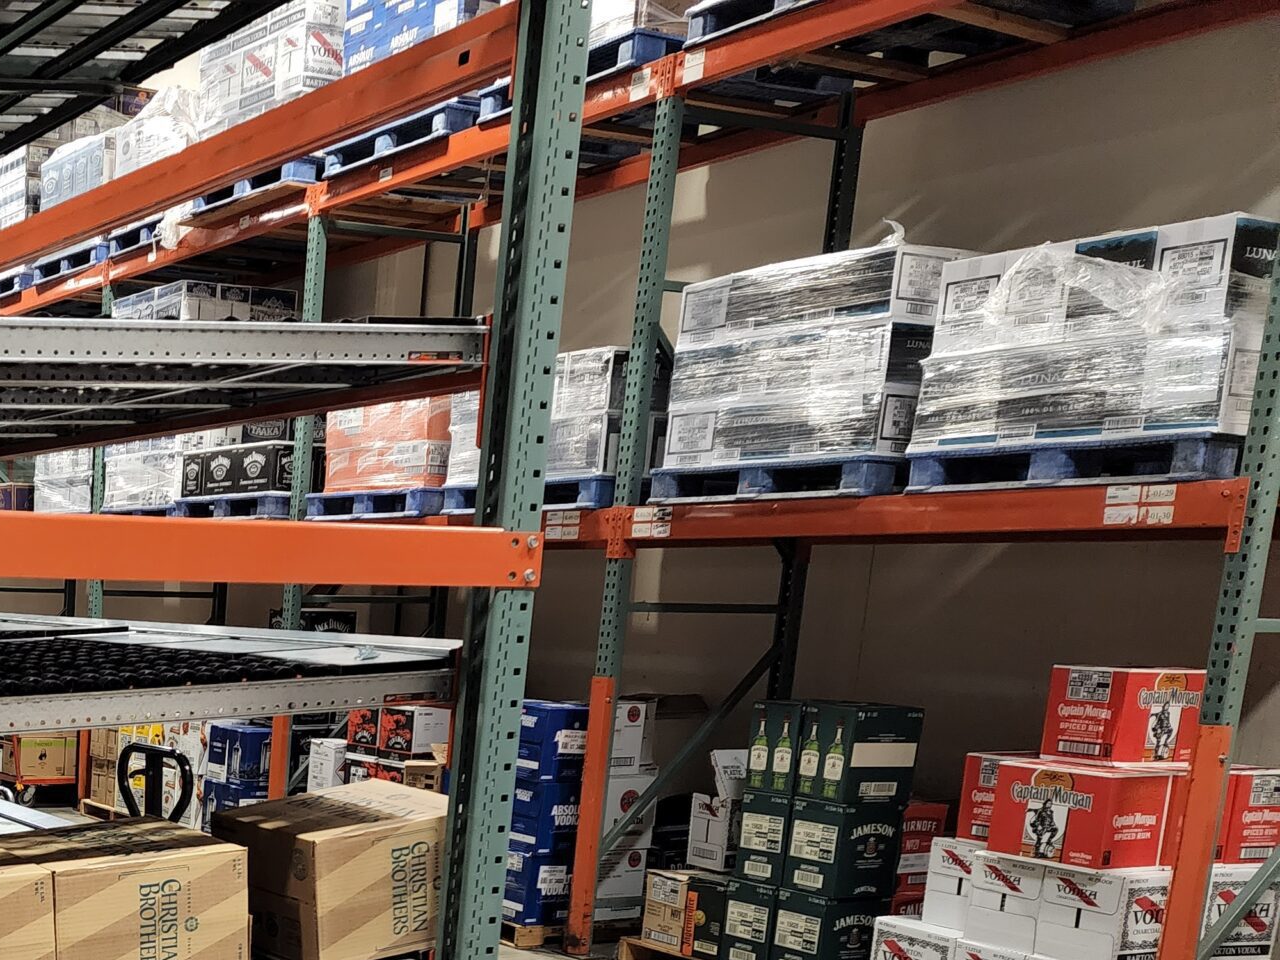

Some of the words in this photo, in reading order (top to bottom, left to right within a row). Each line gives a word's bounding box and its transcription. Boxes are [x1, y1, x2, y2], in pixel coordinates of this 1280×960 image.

[1138, 687, 1170, 710] Captain
[1167, 687, 1201, 710] Morgan
[1059, 722, 1086, 732] SPICED
[1010, 780, 1050, 804] Captain
[1048, 784, 1094, 813] Morgan
[551, 804, 580, 816] ABSOL
[973, 807, 993, 815] SPICE
[850, 823, 896, 840] JAMESON
[902, 820, 937, 833] IRNOFF
[391, 845, 410, 936] BROTHERS
[411, 841, 430, 933] CHRISTIAN
[1133, 908, 1165, 925] VOD
[1237, 946, 1262, 956] VODKA
